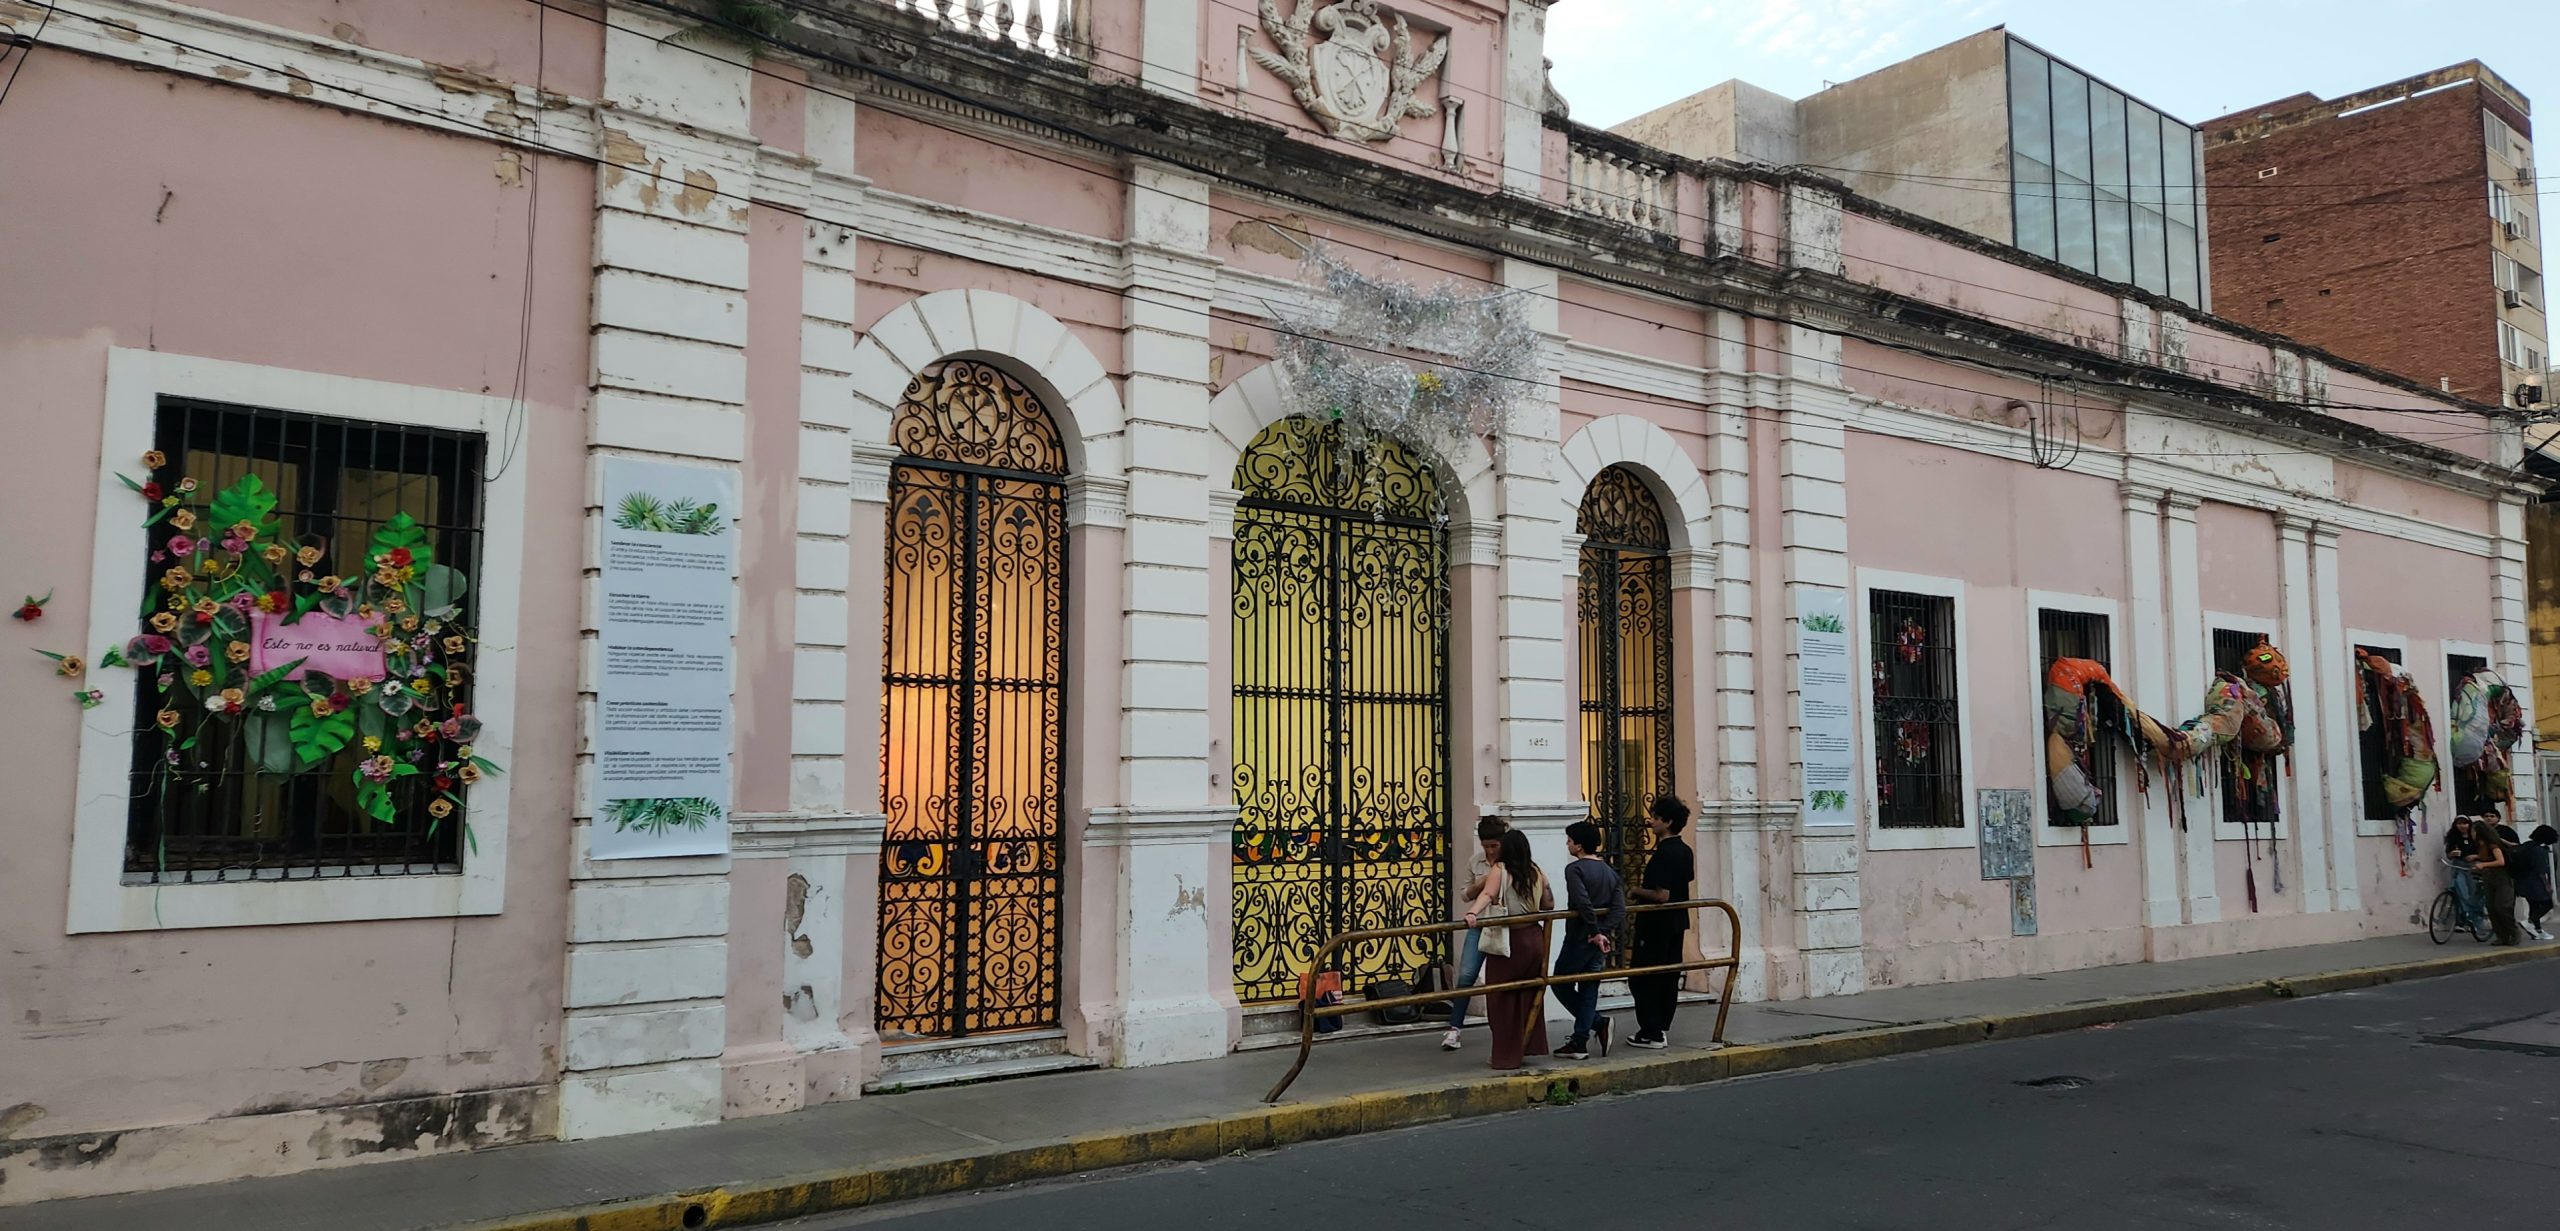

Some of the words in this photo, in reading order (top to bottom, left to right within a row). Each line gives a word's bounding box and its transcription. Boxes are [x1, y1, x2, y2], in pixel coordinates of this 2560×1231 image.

[262, 638, 291, 650] Esto
[295, 642, 313, 650] no
[317, 643, 331, 652] es
[335, 641, 380, 653] natural
